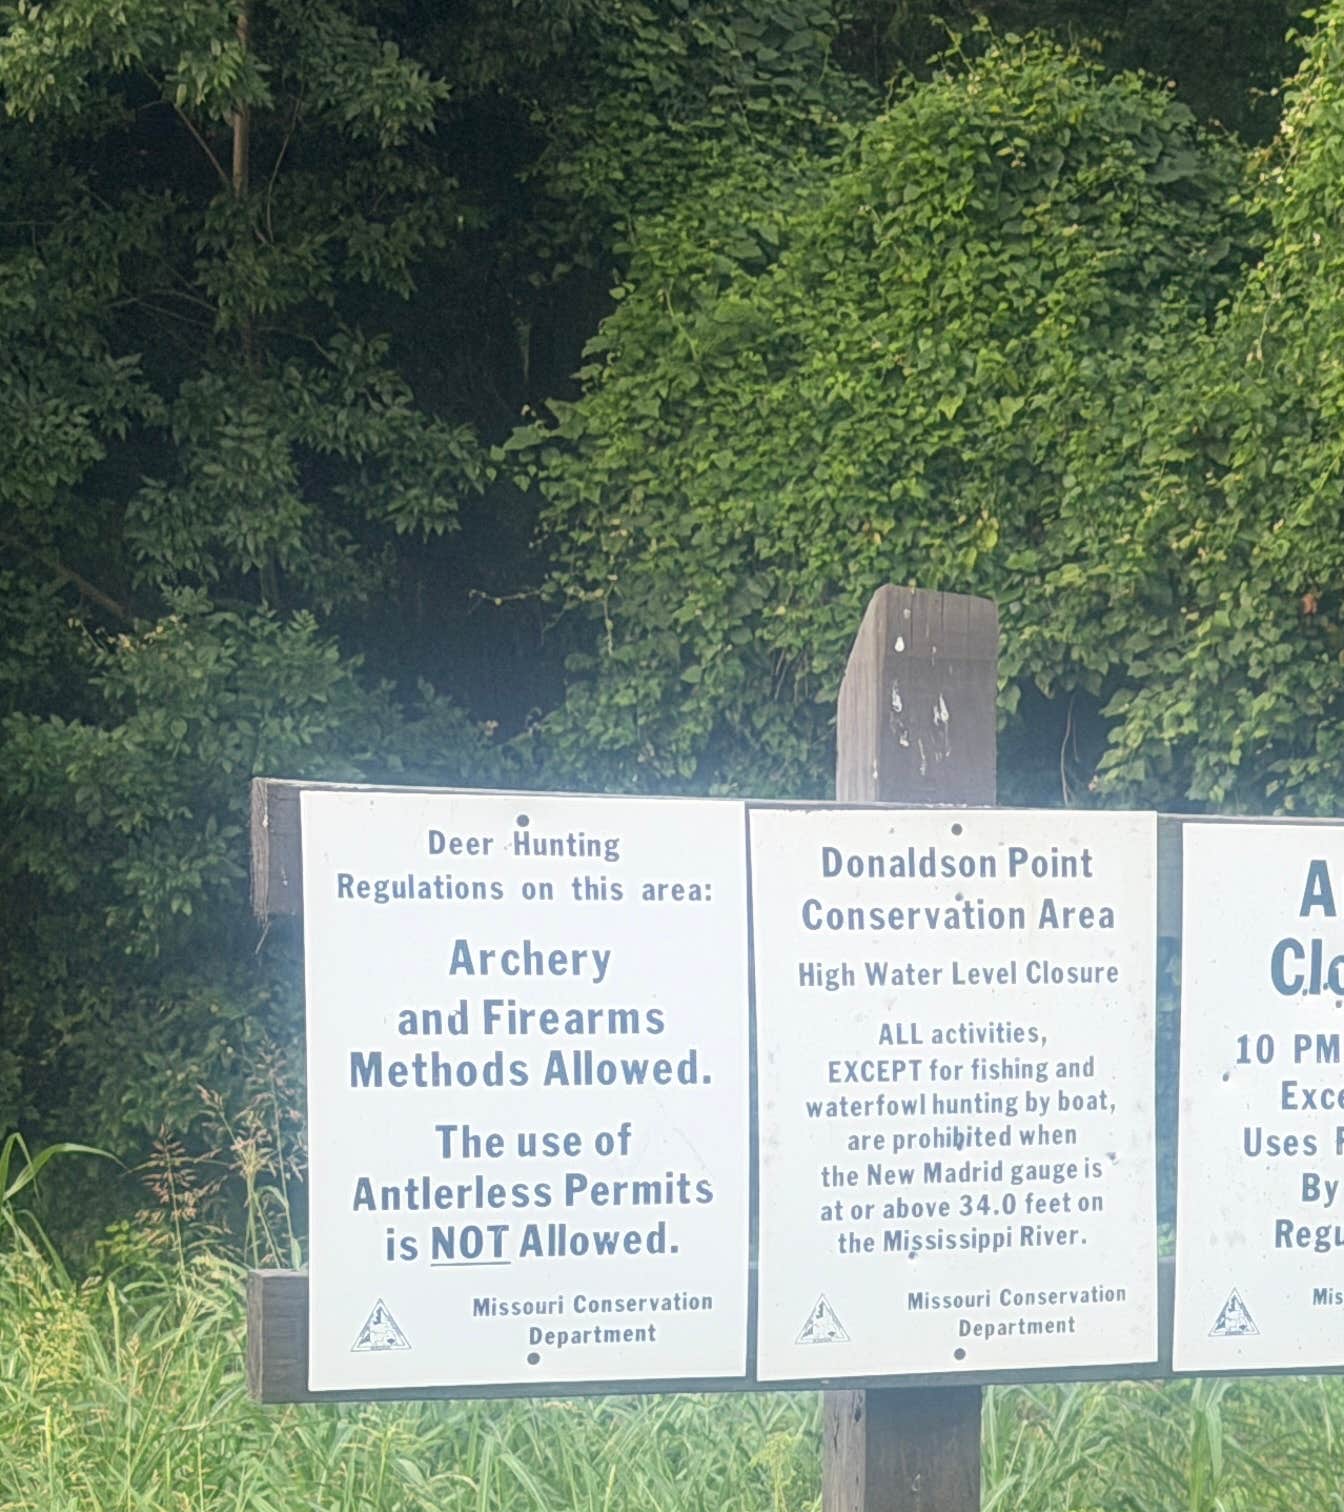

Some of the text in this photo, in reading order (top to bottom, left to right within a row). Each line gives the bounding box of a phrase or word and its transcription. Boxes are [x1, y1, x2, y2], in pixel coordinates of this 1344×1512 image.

[428, 829, 620, 863] Deer Hunting
[821, 846, 1093, 879] Donaldson Point
[337, 872, 712, 905] Regulations on this area:
[801, 897, 1115, 931] Conservation Area
[448, 938, 612, 985] Archery
[798, 959, 1119, 992] High Water Level Closure
[398, 998, 665, 1036] and Firearms
[878, 1020, 1047, 1048] ALL activities,
[1236, 1033, 1275, 1065] 10
[1294, 1033, 1341, 1064] PM
[350, 1048, 712, 1088] Methods Allowed.
[828, 1055, 1095, 1084] EXCEPT for fishing and
[805, 1089, 1116, 1118] waterfowl hunting by boat,
[434, 1121, 632, 1160] The use of
[847, 1123, 1077, 1155] are prohibited when
[1243, 1126, 1318, 1158] Uses
[820, 1159, 1103, 1188] the New Madrid gauge is
[352, 1171, 714, 1212] Antlerless Permits
[820, 1191, 1103, 1222] at or above 34.0 feet on
[1301, 1172, 1339, 1209] By
[386, 1220, 679, 1262] is NOT Allowed.
[837, 1224, 1087, 1254] the Mississippi River.
[472, 1291, 713, 1317] Missouri Conservation
[907, 1284, 1126, 1311] Missouri Conservation
[529, 1323, 657, 1349] Department
[958, 1315, 1076, 1341] Department
